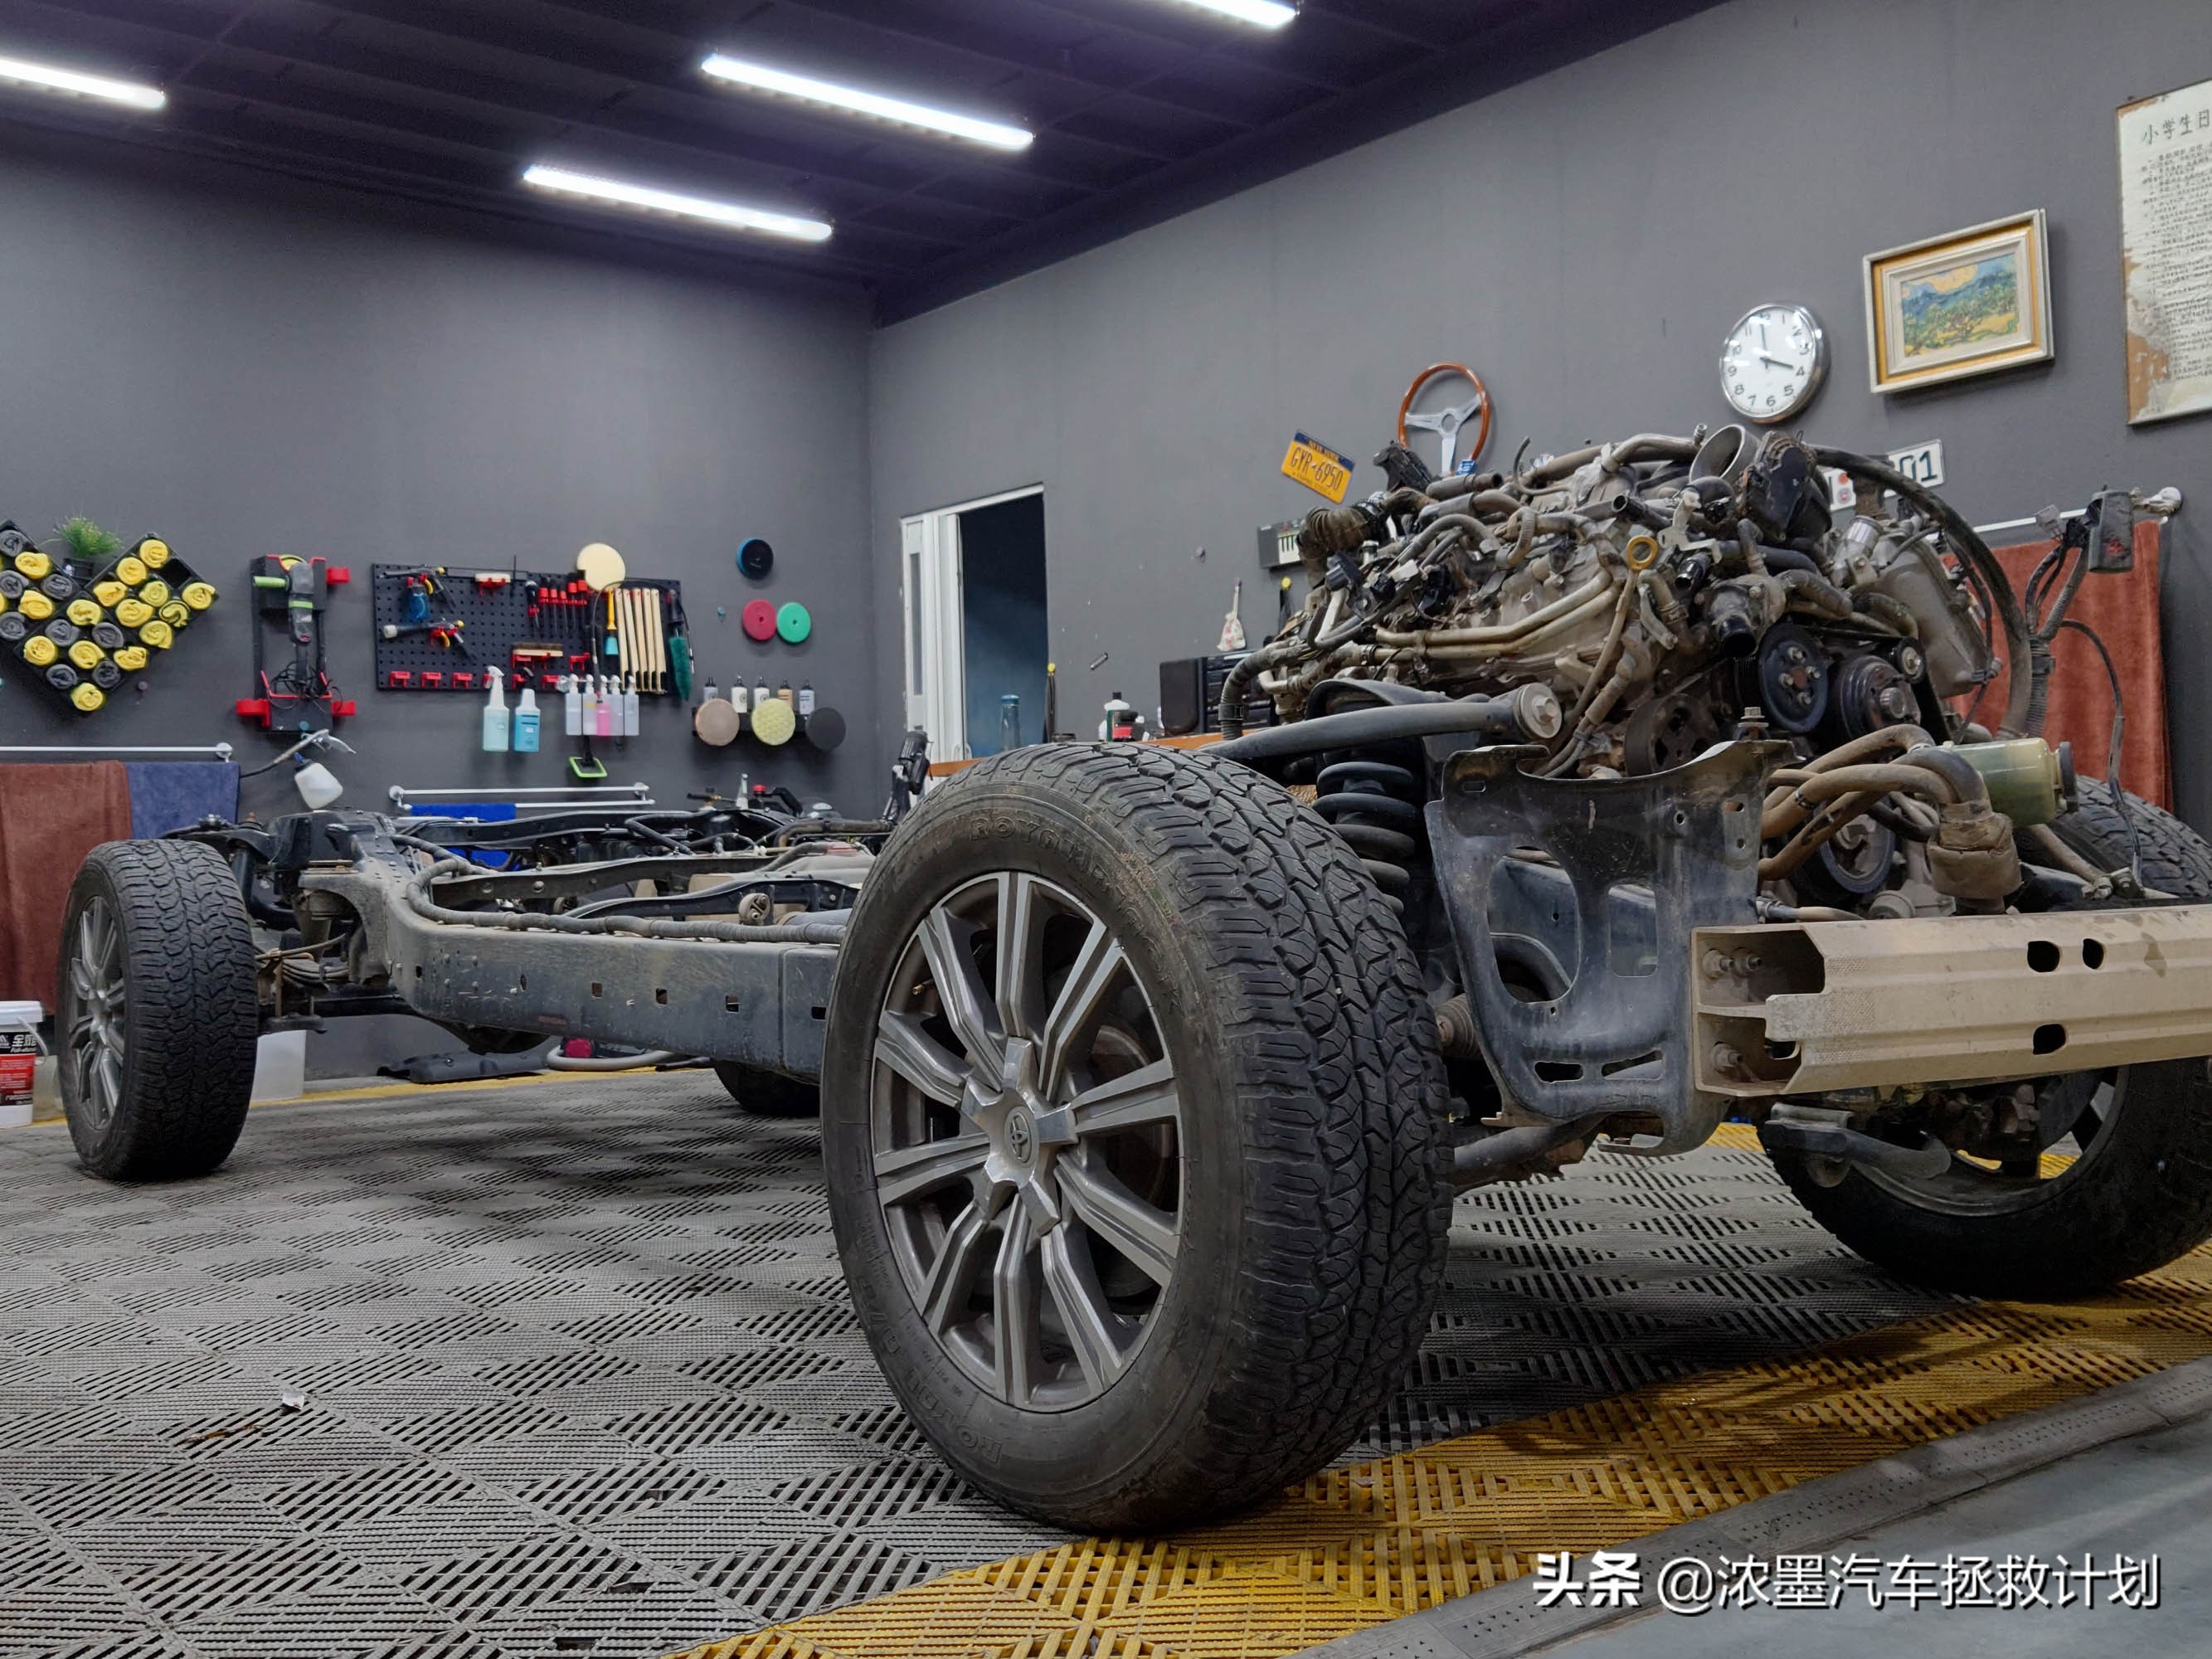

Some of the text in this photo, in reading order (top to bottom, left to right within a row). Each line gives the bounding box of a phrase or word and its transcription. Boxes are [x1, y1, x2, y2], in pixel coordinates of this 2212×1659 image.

[1728, 366, 1737, 377] 9
[1796, 367, 1805, 377] 4
[1734, 384, 1744, 395] 8
[1784, 385, 1794, 397] 5
[1748, 395, 1757, 406] 7
[1766, 396, 1776, 406] 6
